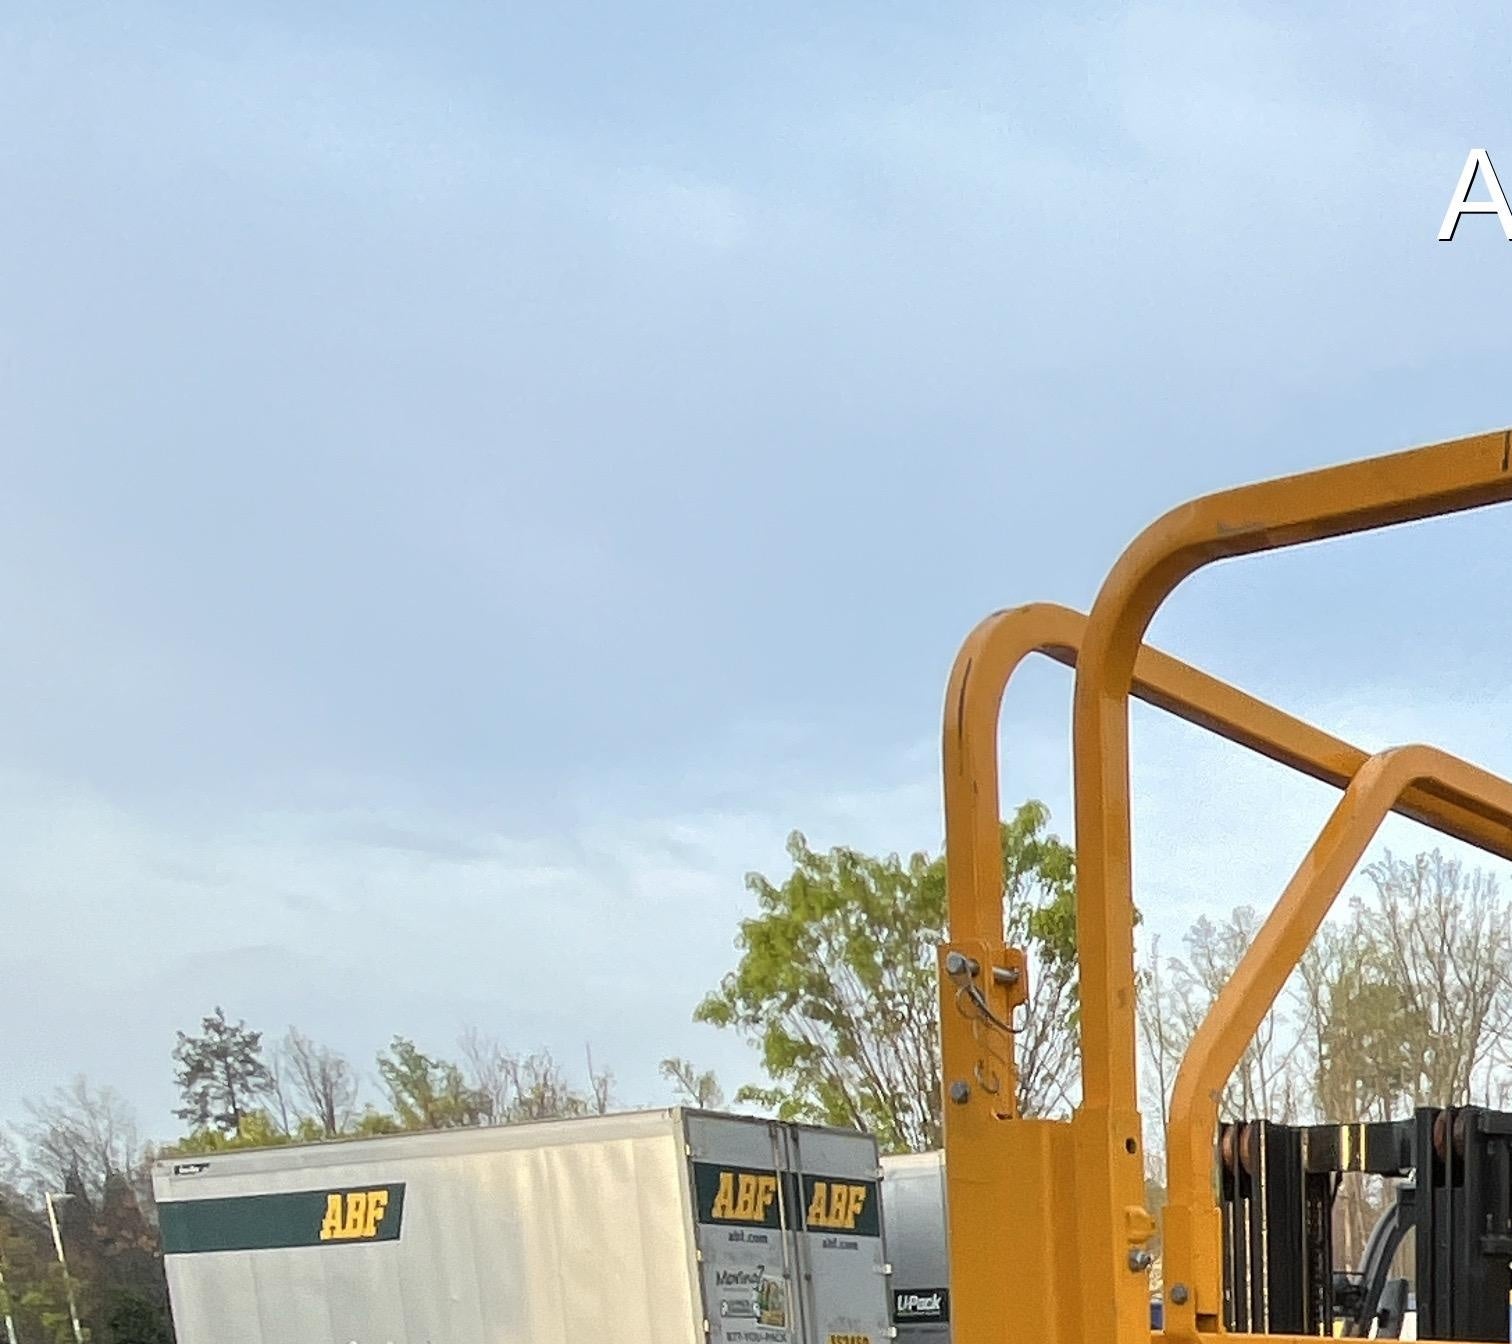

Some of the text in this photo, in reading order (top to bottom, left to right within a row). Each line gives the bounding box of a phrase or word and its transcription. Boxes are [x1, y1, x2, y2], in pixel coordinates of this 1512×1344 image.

[319, 1189, 389, 1241] ABF
[712, 1171, 777, 1222] ABF
[806, 1180, 867, 1230] ABF
